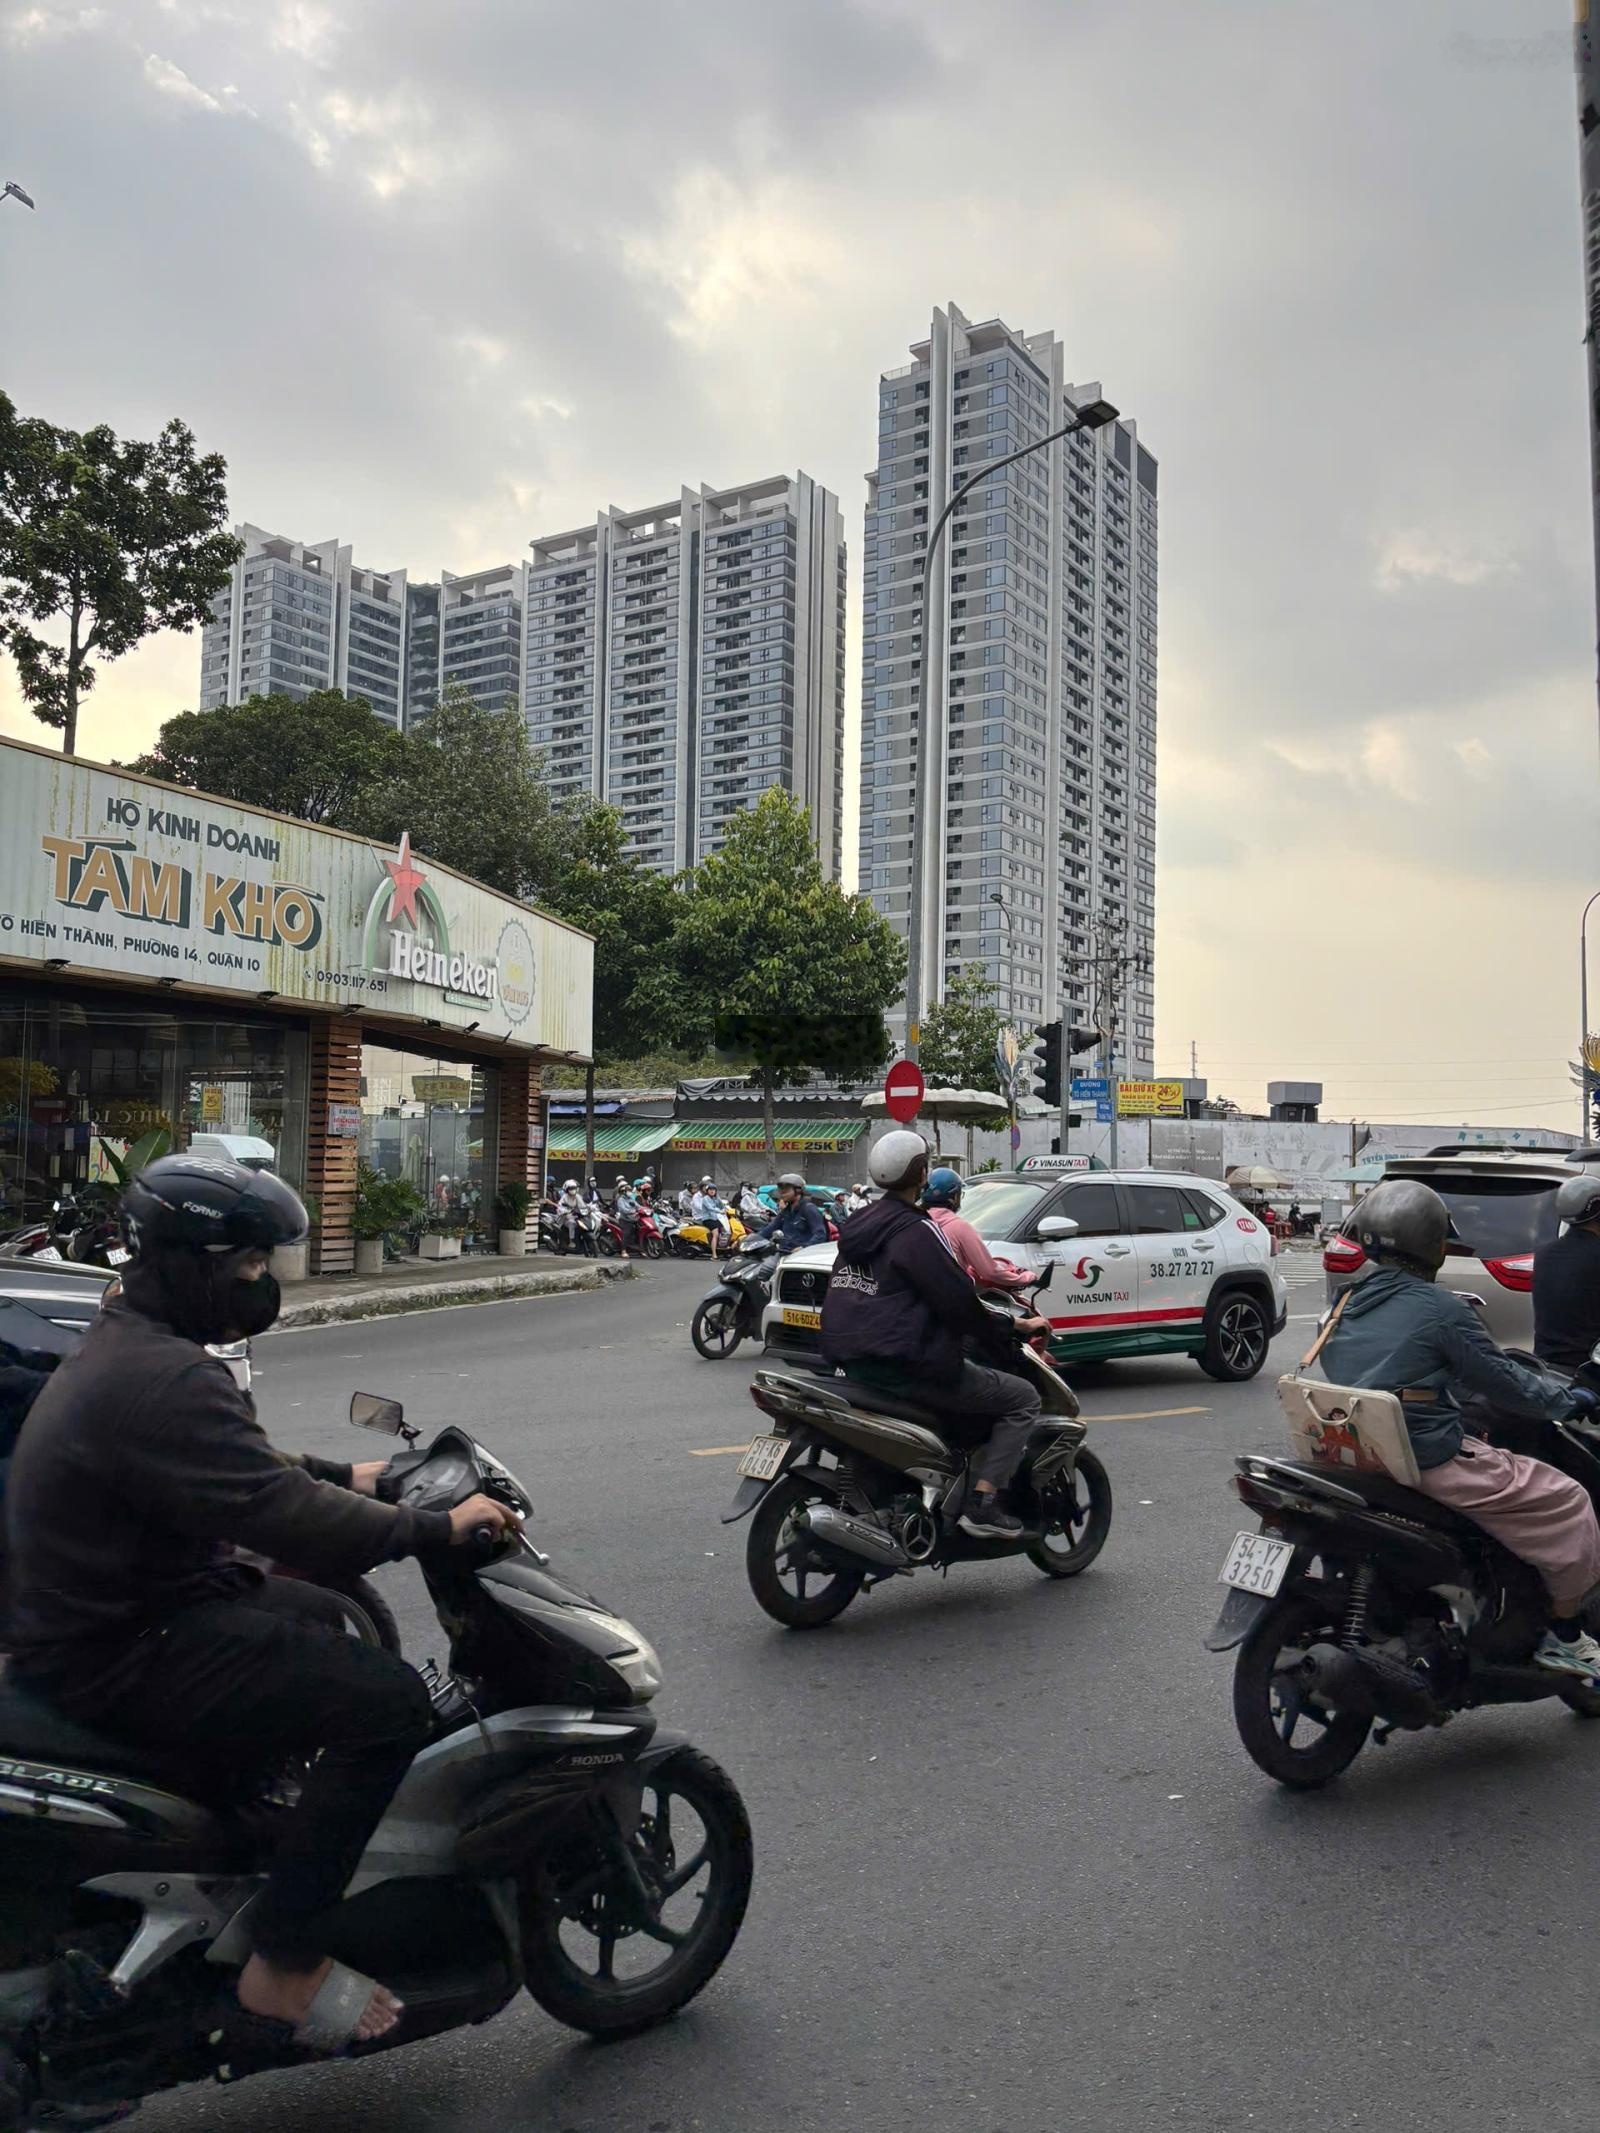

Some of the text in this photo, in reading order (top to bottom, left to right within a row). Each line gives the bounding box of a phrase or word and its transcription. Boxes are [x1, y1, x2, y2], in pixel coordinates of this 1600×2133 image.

[107, 797, 281, 862] HỘ KINH DOANH
[247, 958, 260, 972] 10
[388, 929, 498, 999] Heineken
[317, 970, 387, 992] 0903.117.651
[746, 1140, 766, 1150] NH
[804, 1141, 833, 1151] 25K
[182, 1201, 224, 1219] FORNIX
[1150, 1260, 1214, 1278] 38.27 27 27
[831, 1274, 880, 1297] adidas
[1066, 1291, 1129, 1305] VINASUN TAXI
[1238, 1538, 1284, 1566] 54-Y7
[1229, 1561, 1274, 1590] 3250
[570, 1752, 625, 1767] HONDA
